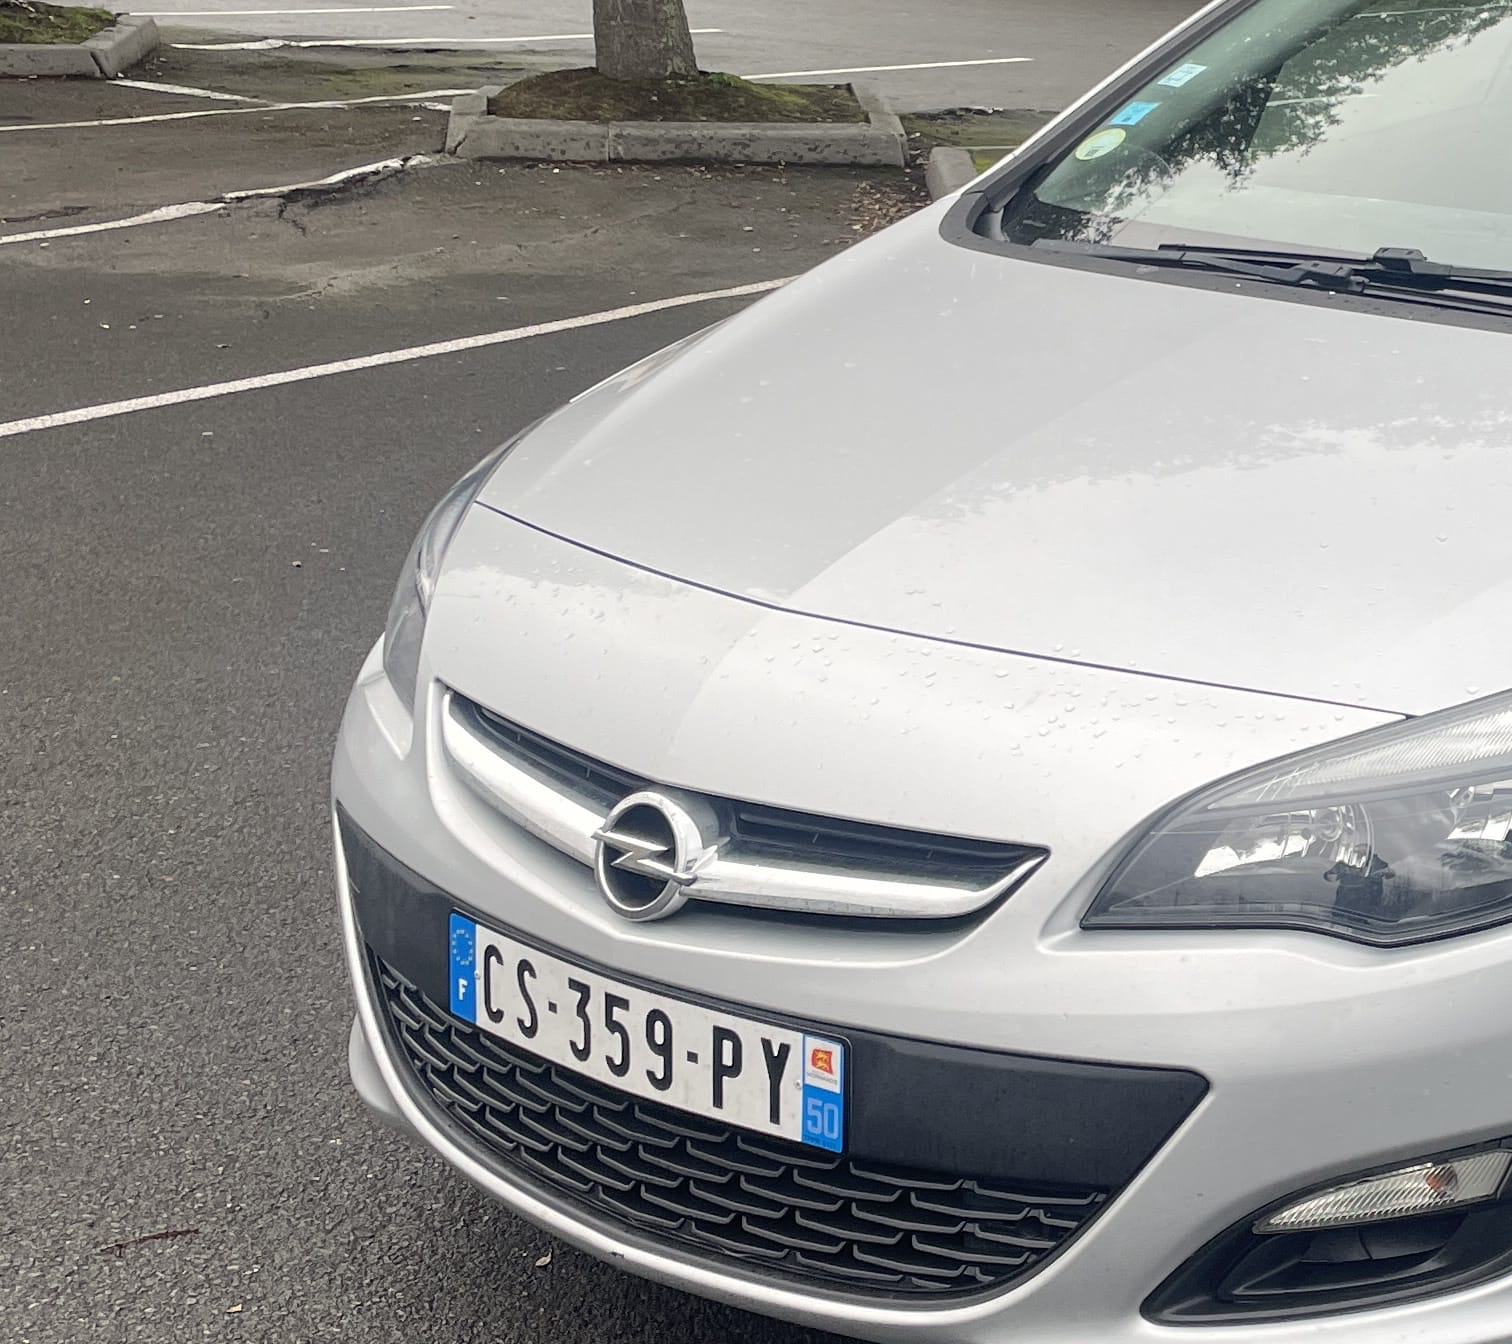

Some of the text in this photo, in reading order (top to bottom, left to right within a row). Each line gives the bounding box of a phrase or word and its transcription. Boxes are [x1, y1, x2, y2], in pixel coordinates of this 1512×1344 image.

[458, 977, 468, 1001] F
[484, 944, 790, 1125] CS-359-PY
[807, 1097, 839, 1140] 50
